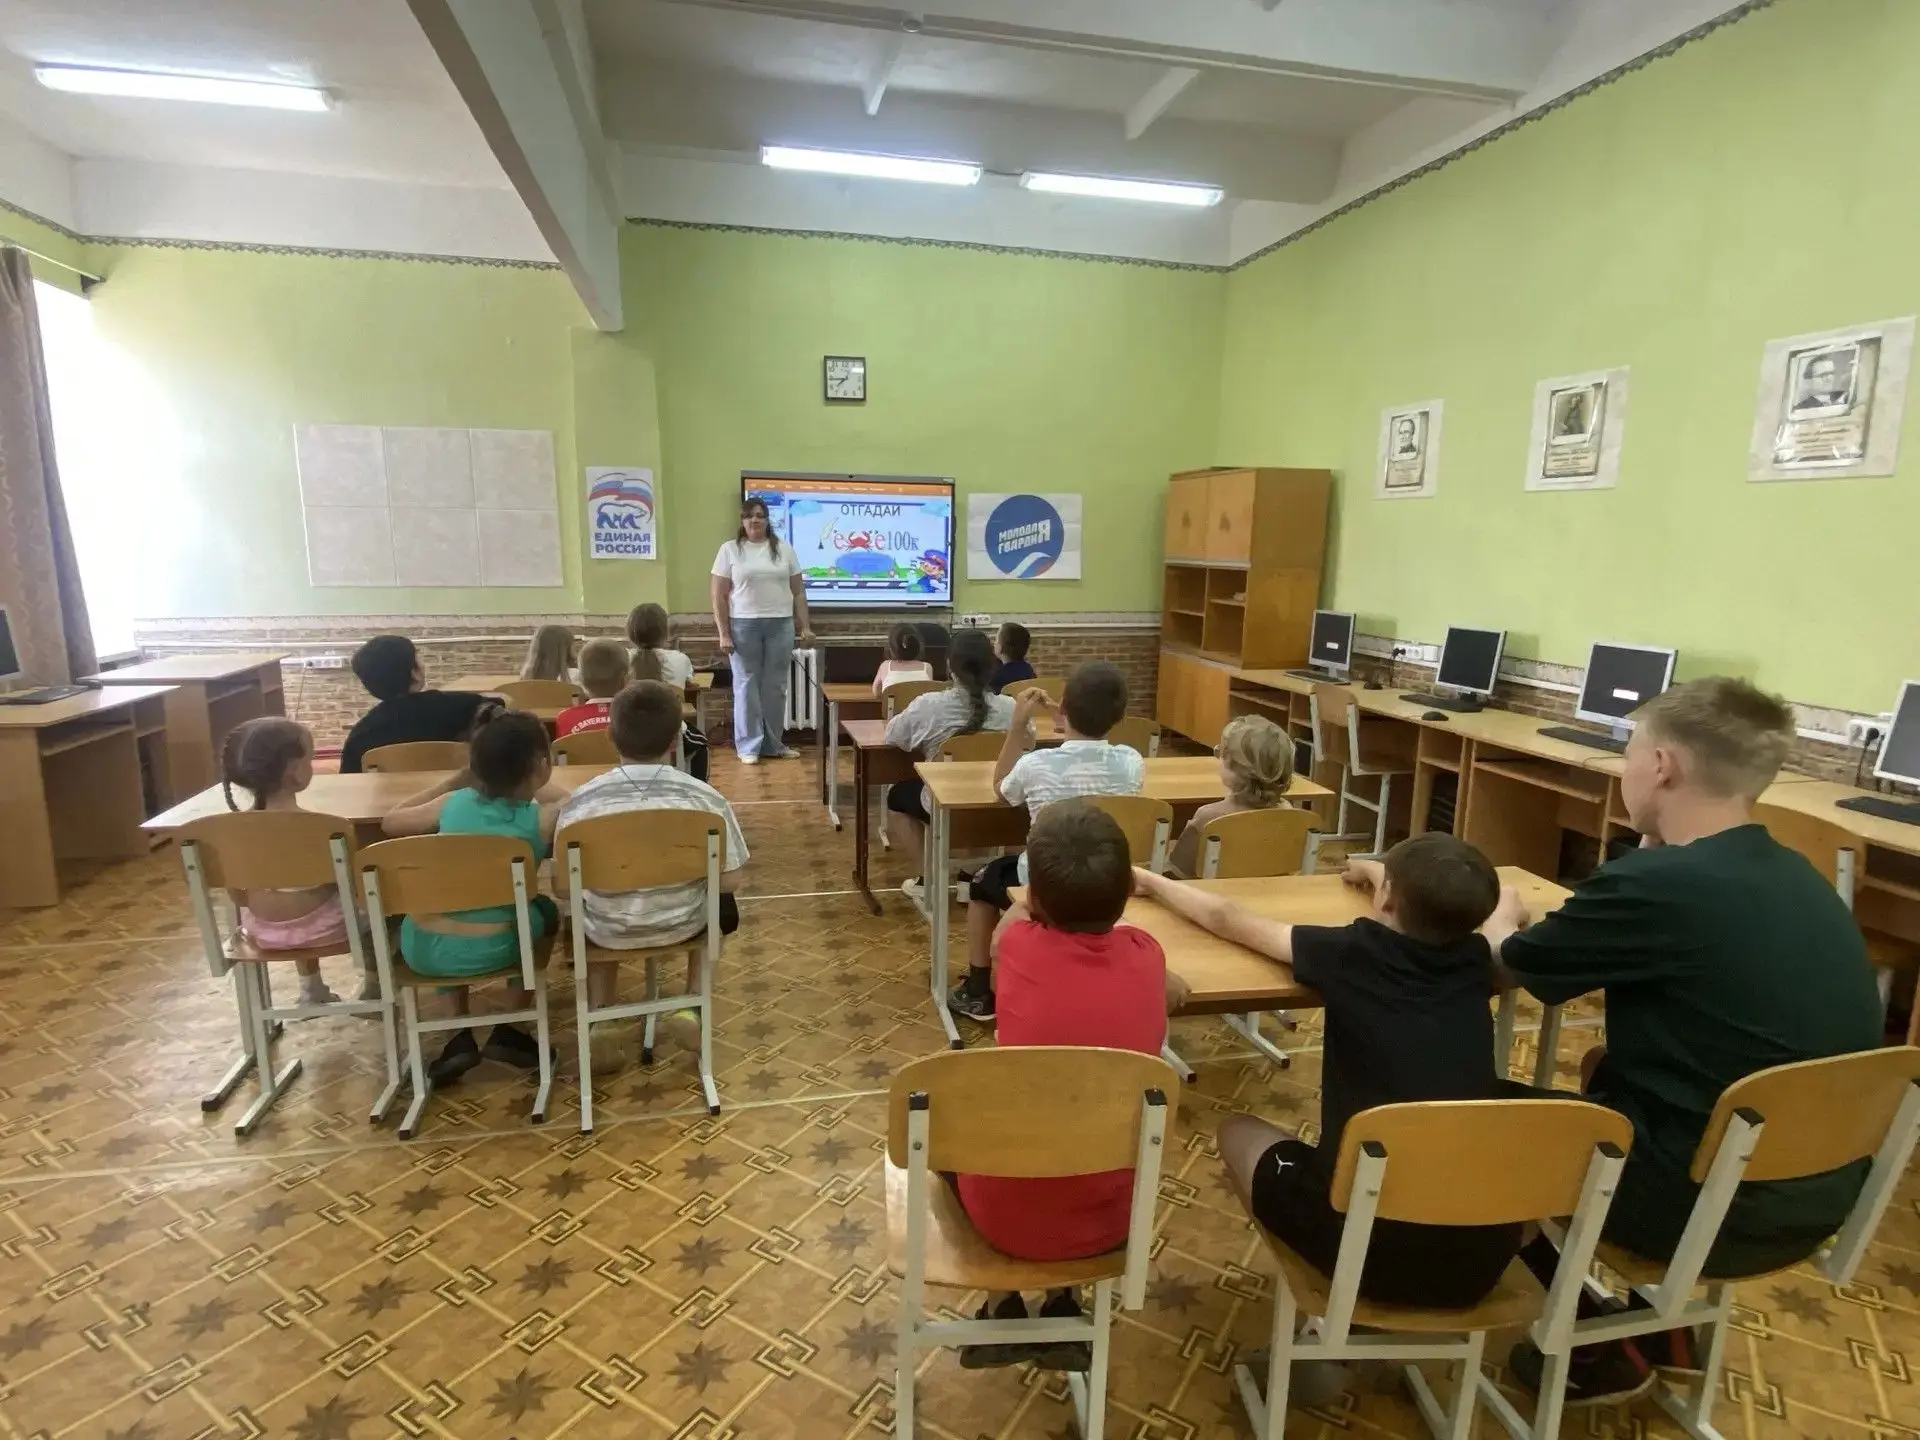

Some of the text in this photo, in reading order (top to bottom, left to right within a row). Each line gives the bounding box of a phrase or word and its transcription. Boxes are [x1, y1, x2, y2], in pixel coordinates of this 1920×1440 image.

[840, 503, 901, 517] ОТГАДАЙ
[594, 532, 651, 542] ЕДИНАЯ
[595, 543, 651, 554] РОССИЯ
